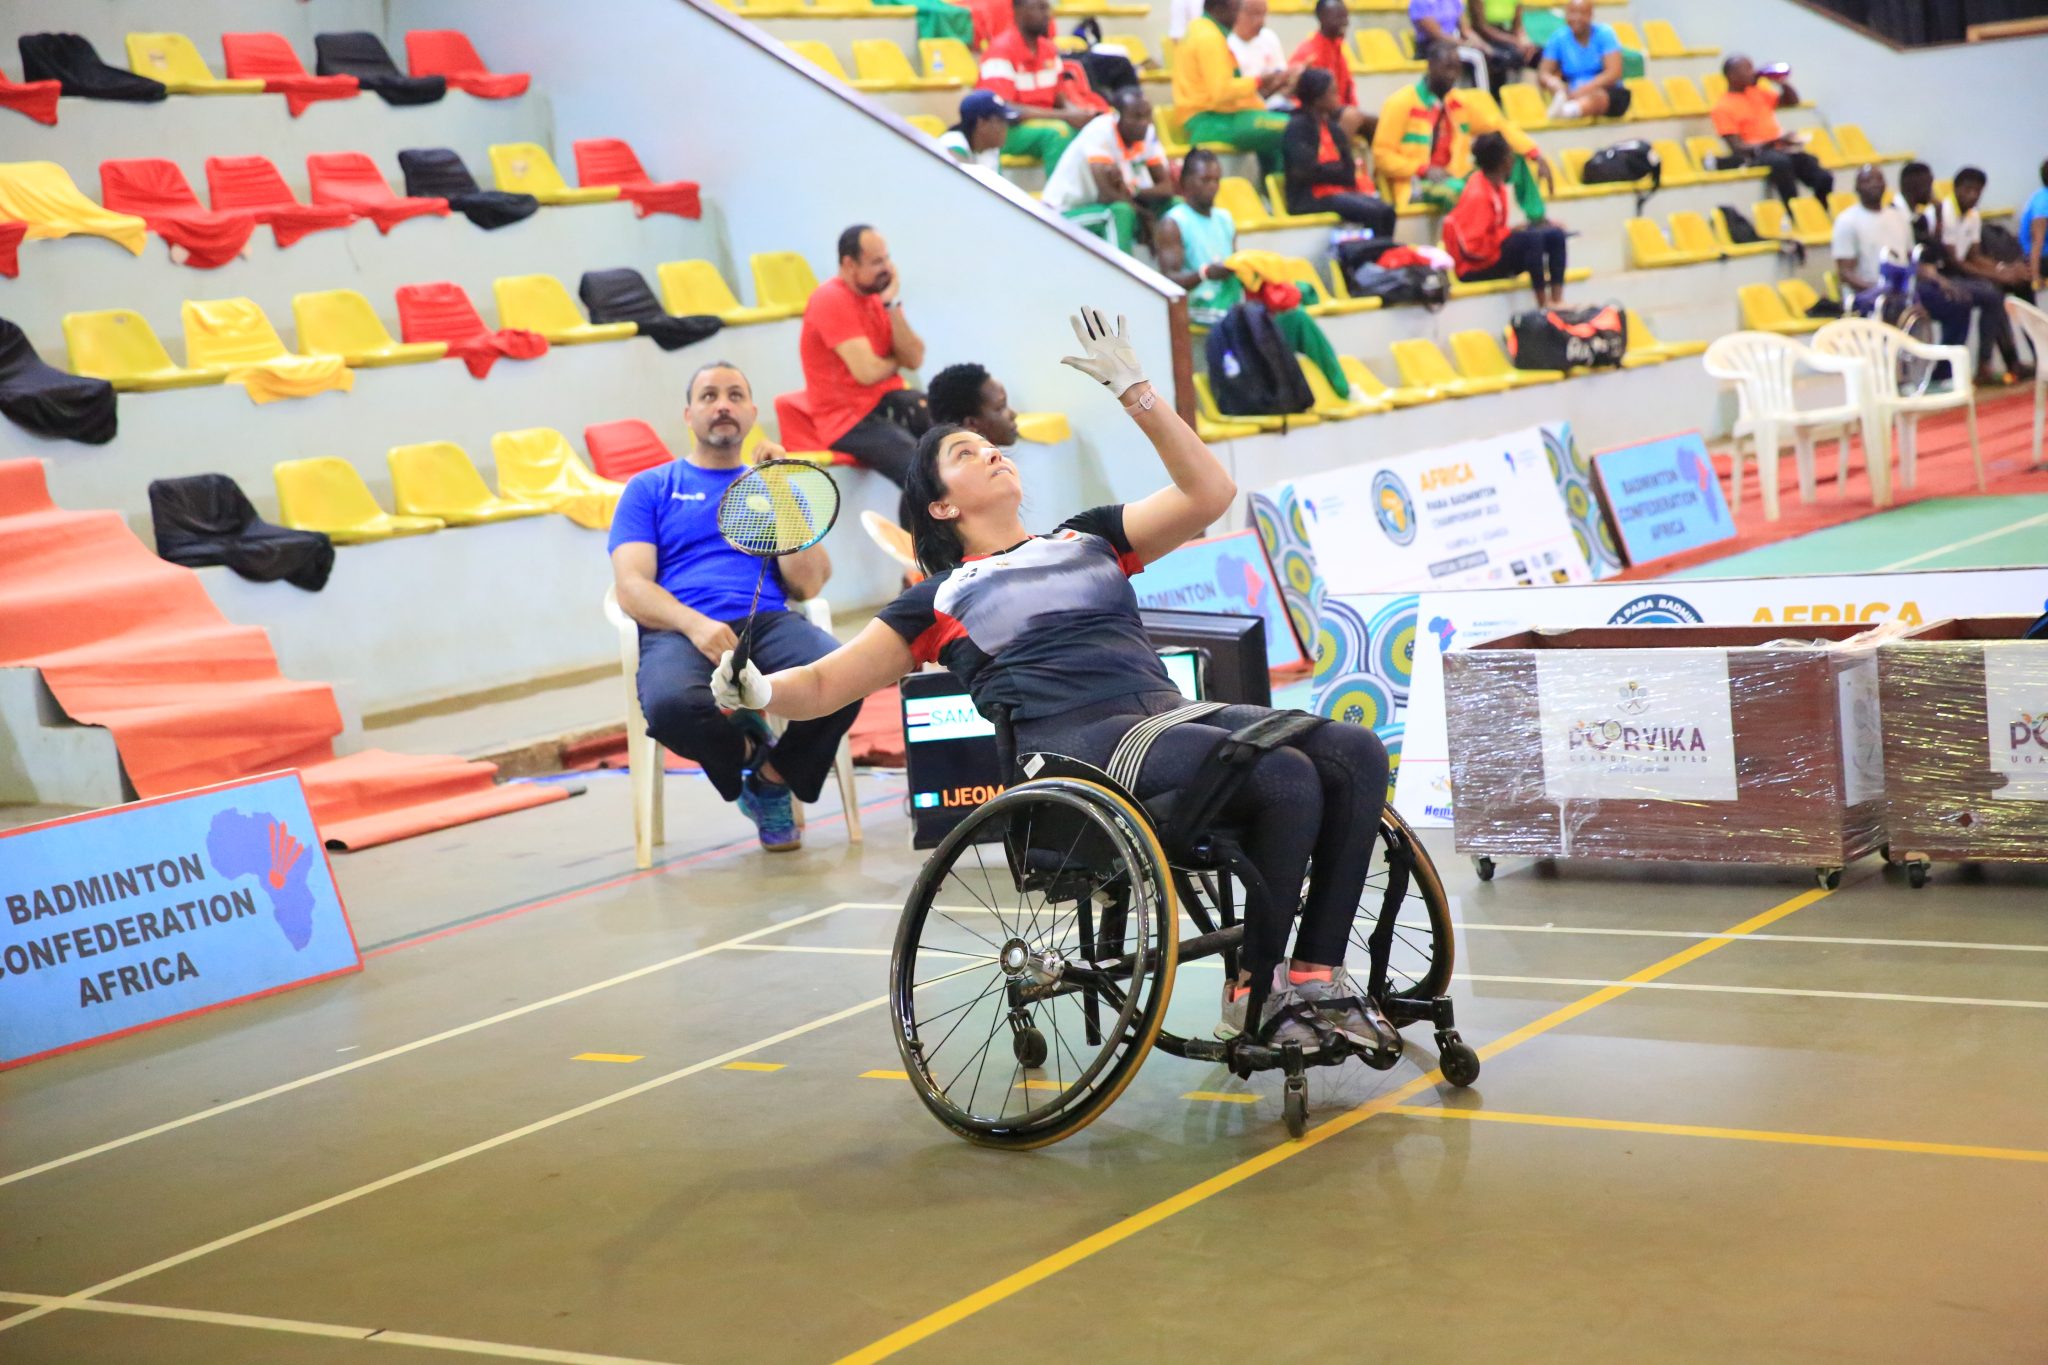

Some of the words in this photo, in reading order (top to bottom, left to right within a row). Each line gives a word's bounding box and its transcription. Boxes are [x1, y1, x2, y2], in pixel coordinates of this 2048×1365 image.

[1139, 581, 1217, 608] ADMINTON
[1623, 599, 1654, 619] PARA
[1569, 720, 1706, 751] PORVIKA
[5, 853, 205, 925] BADMINTON
[0, 888, 257, 980] ONFEDERATION
[80, 952, 199, 1008] AFRICA
